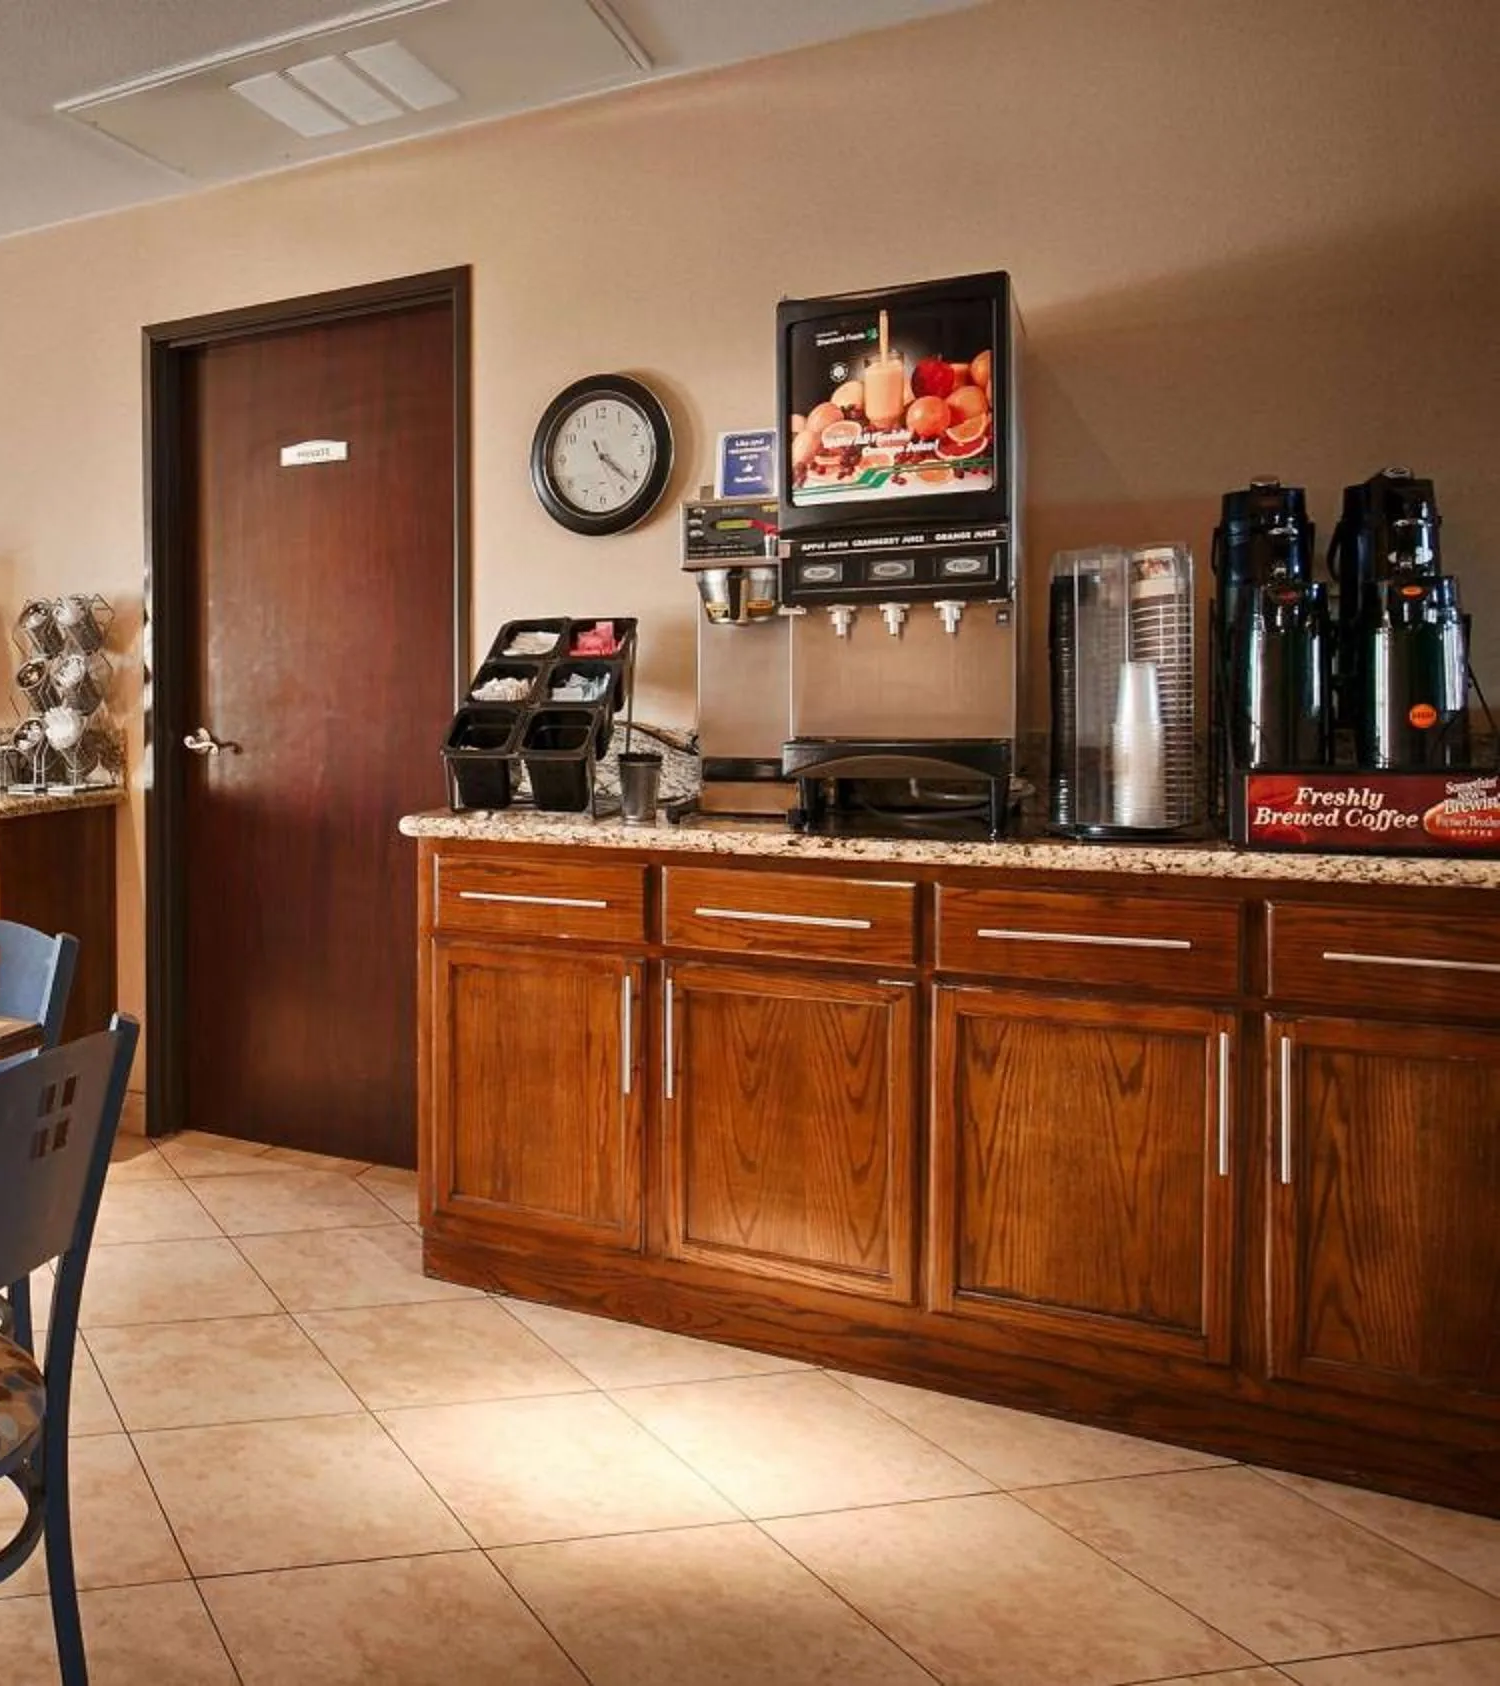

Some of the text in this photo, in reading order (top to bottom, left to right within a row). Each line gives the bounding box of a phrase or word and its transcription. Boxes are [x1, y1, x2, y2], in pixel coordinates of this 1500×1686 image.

[596, 407, 606, 419] 12
[576, 416, 587, 429] 11
[566, 434, 577, 445] 10
[901, 534, 925, 544] JUICE
[934, 529, 997, 541] ORANGE JUICE
[1294, 787, 1385, 811] Freshly
[1254, 807, 1419, 832] Brewed Coffee
